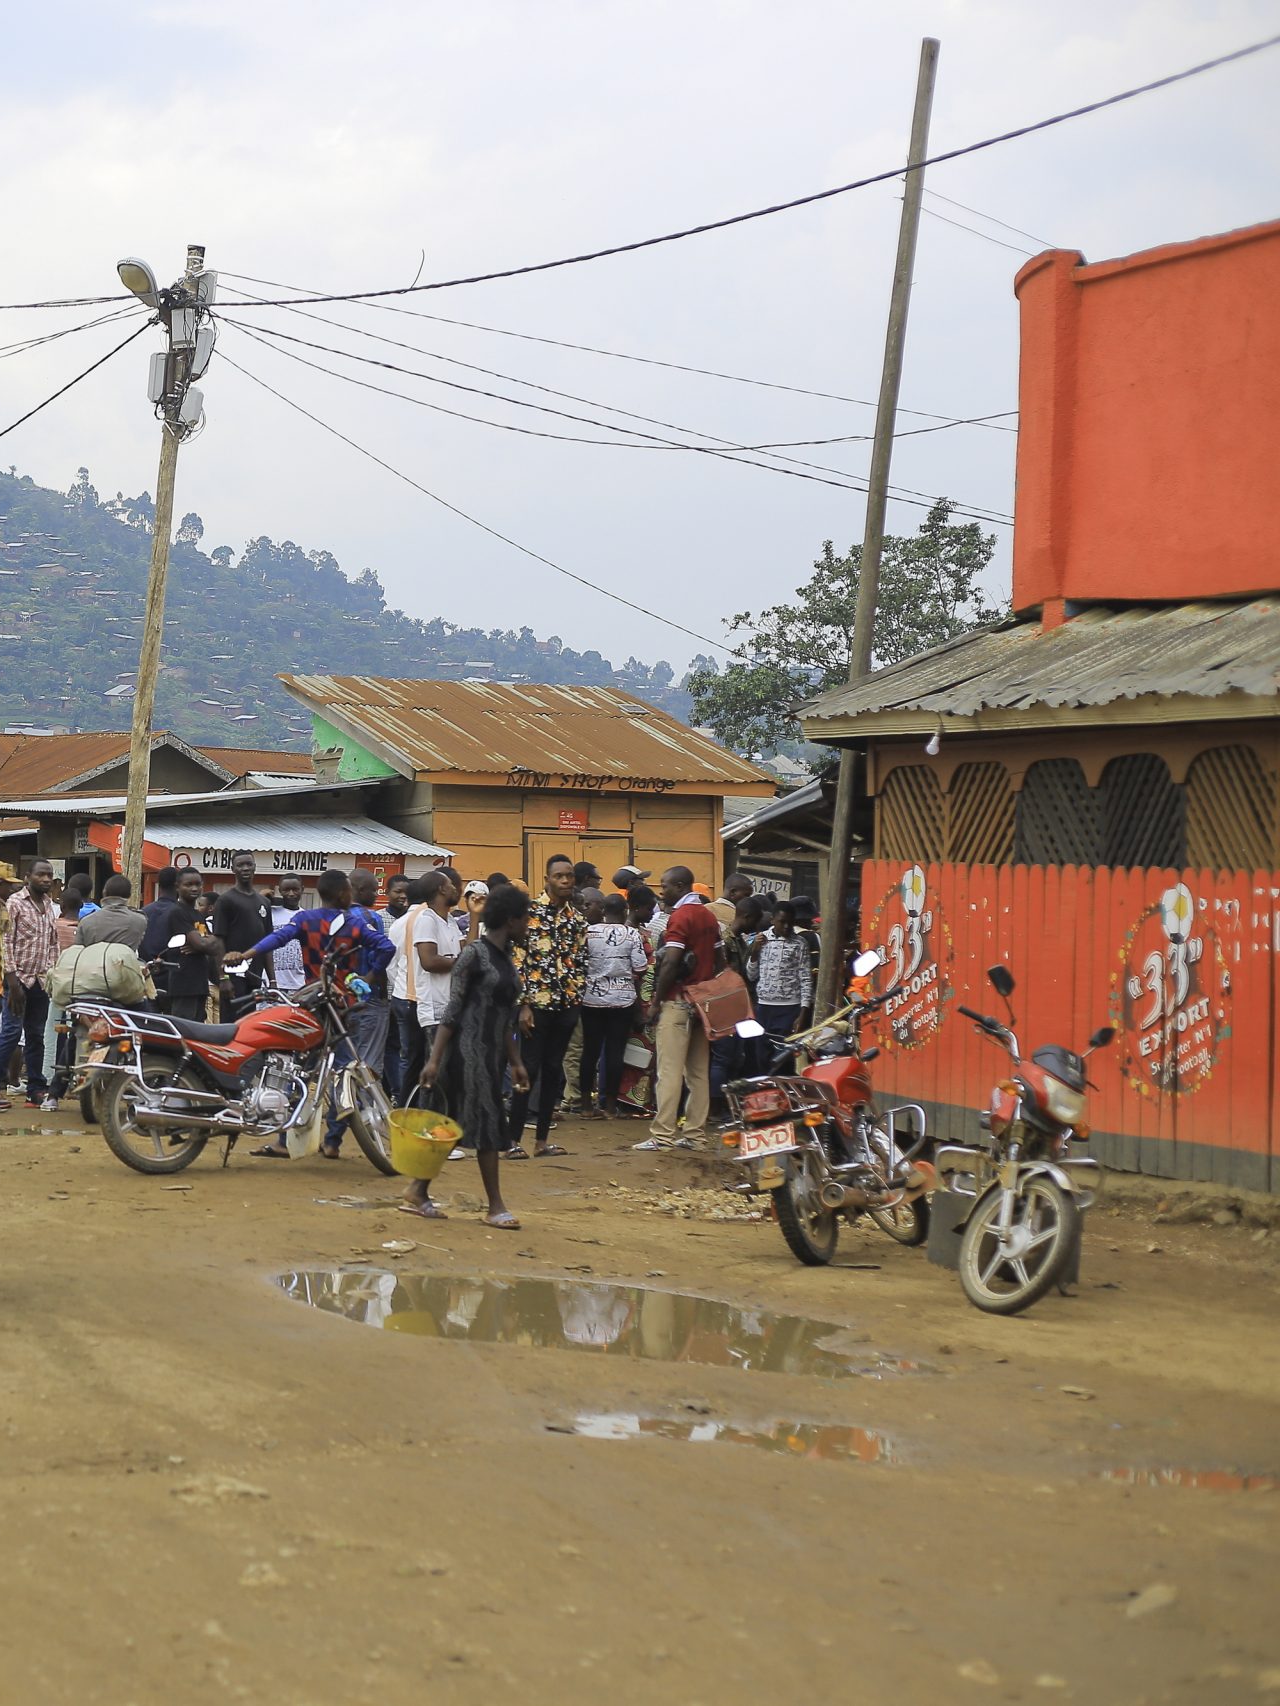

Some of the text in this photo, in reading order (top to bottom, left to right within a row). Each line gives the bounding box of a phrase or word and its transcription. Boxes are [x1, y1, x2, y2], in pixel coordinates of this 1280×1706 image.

[560, 773, 614, 790] SHOP
[618, 777, 675, 792] Orange
[273, 850, 328, 871] SALVANIE
[885, 963, 937, 1015] EXPORT
[892, 1000, 923, 1031] Supporter
[1139, 997, 1210, 1056] EXPORT
